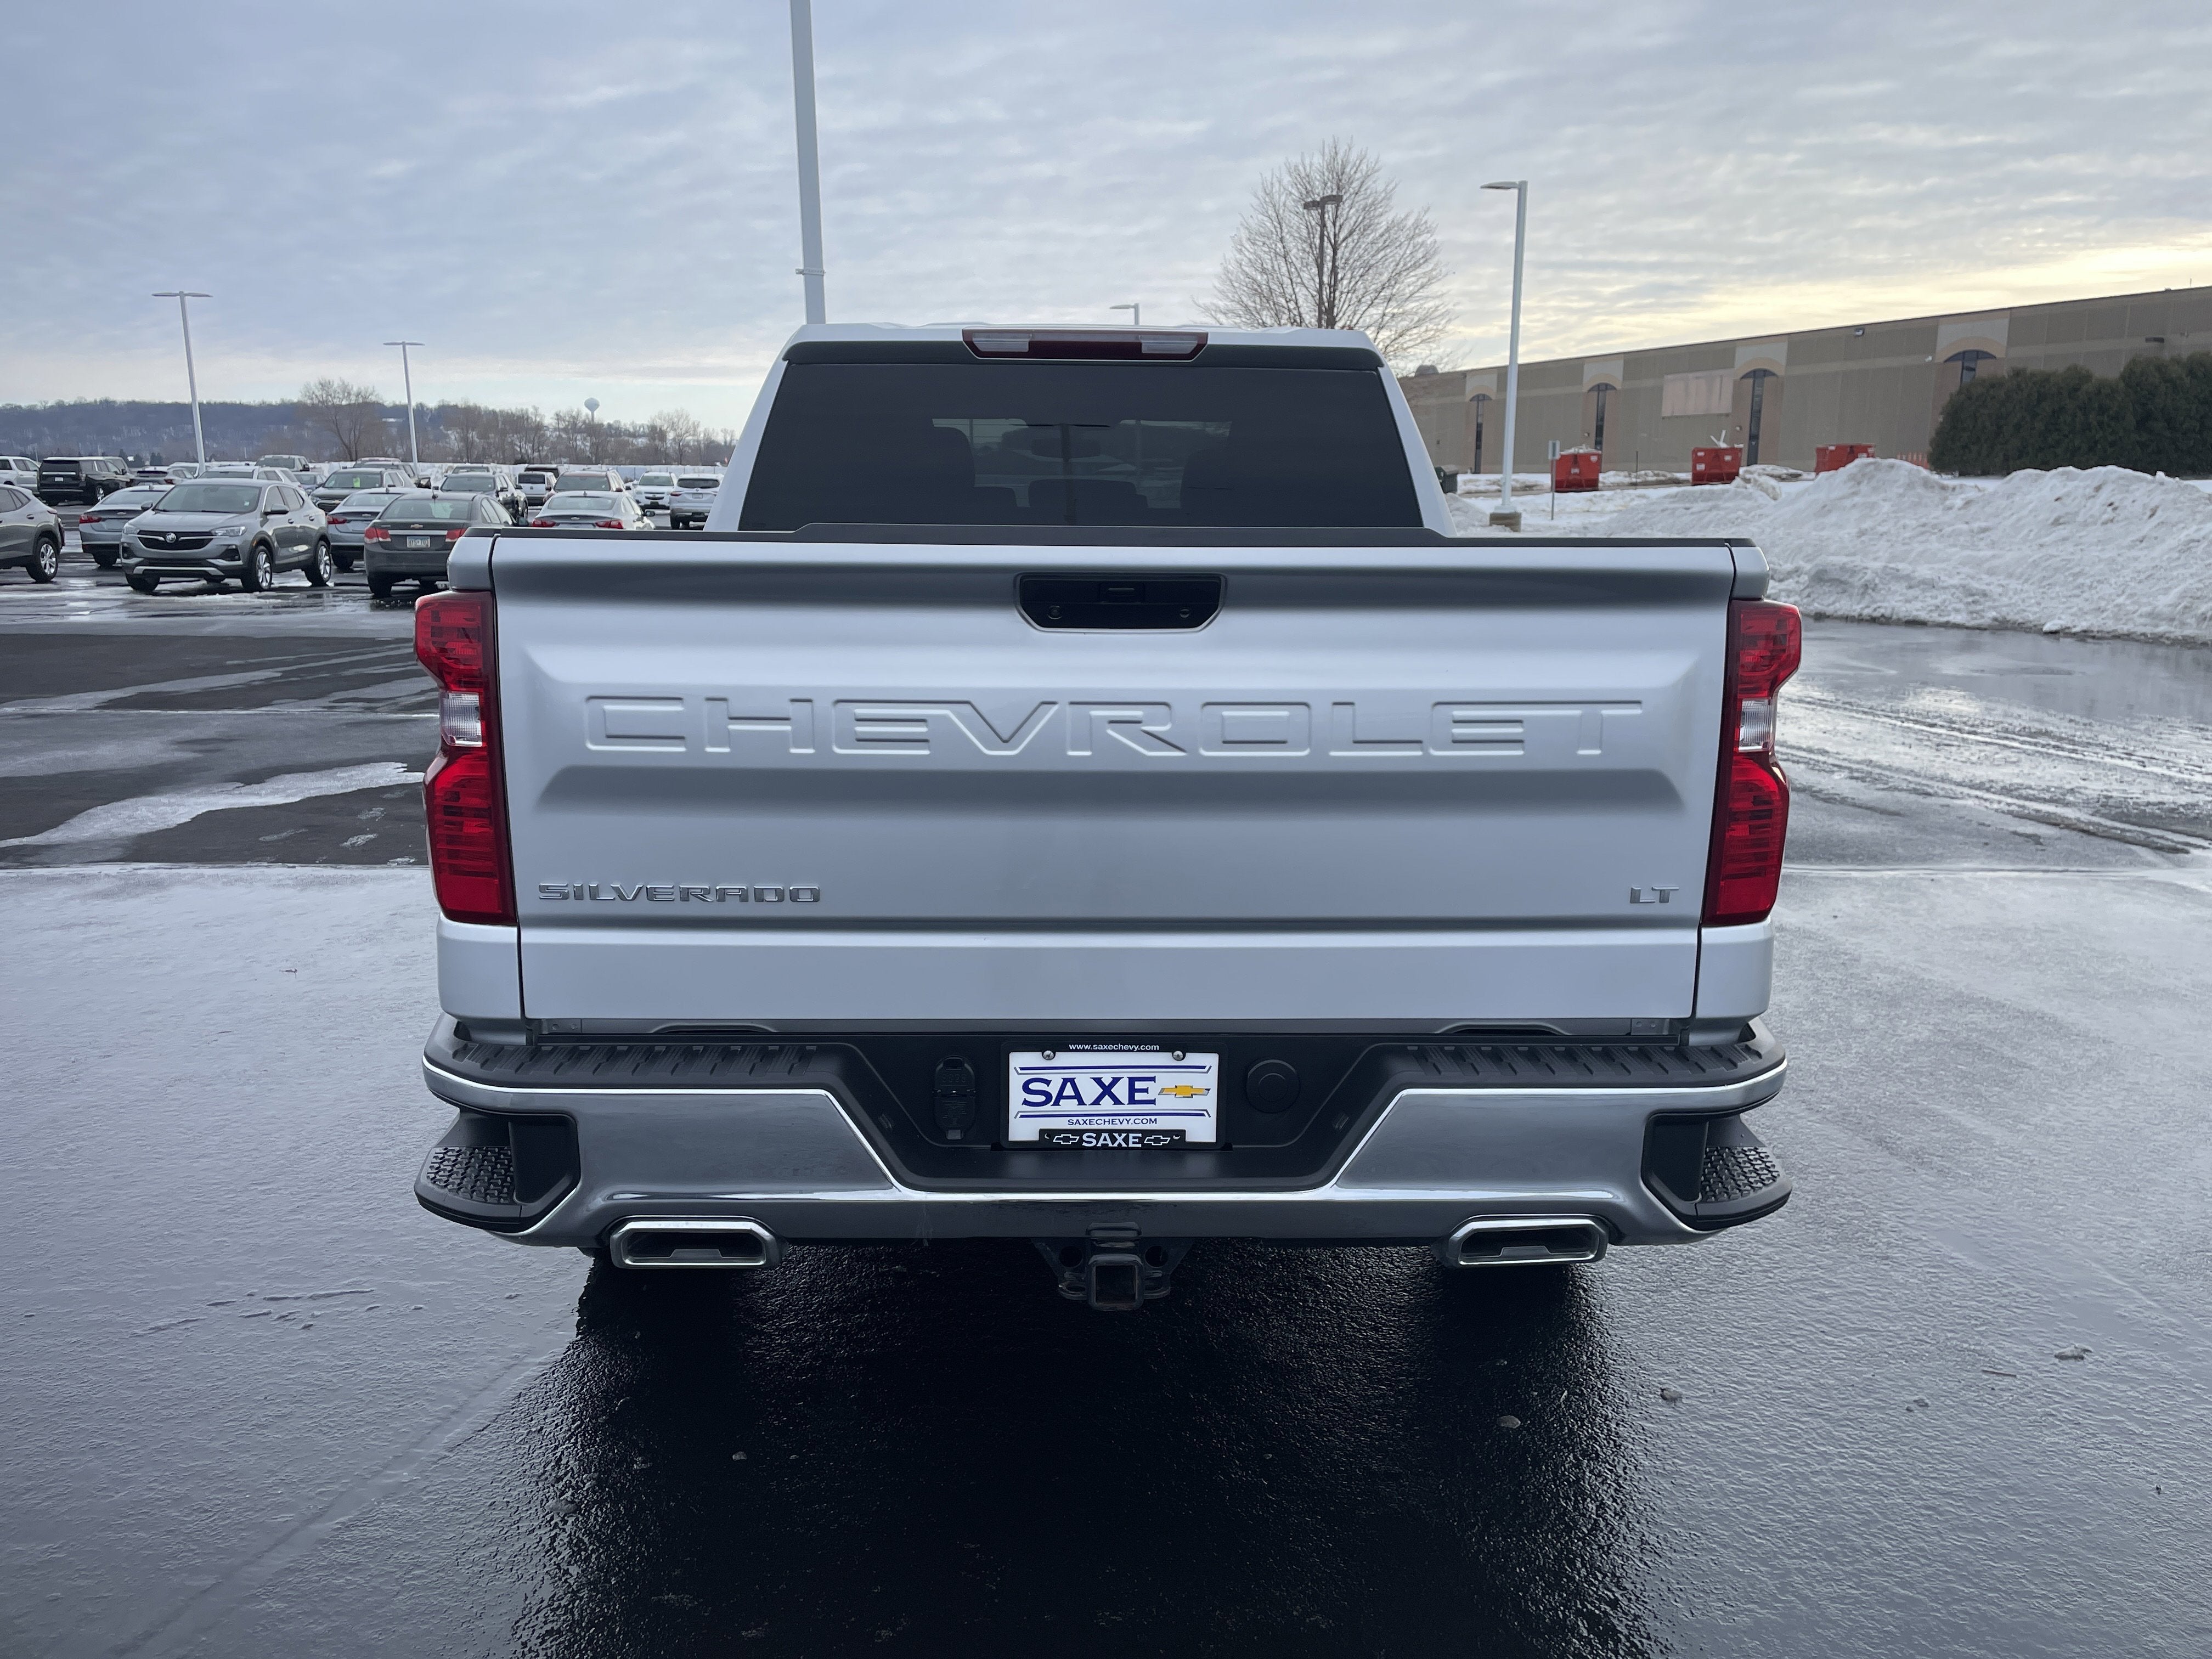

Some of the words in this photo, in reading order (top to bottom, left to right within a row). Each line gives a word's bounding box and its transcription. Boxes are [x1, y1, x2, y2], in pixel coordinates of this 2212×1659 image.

[585, 695, 1643, 757] CHEVROLET
[538, 882, 820, 902] SILVERADO
[1629, 886, 1679, 904] LT
[1069, 1043, 1159, 1052] www.saxechevy.com
[1022, 1076, 1156, 1107] SAXE
[1082, 1132, 1142, 1148] SAXE
